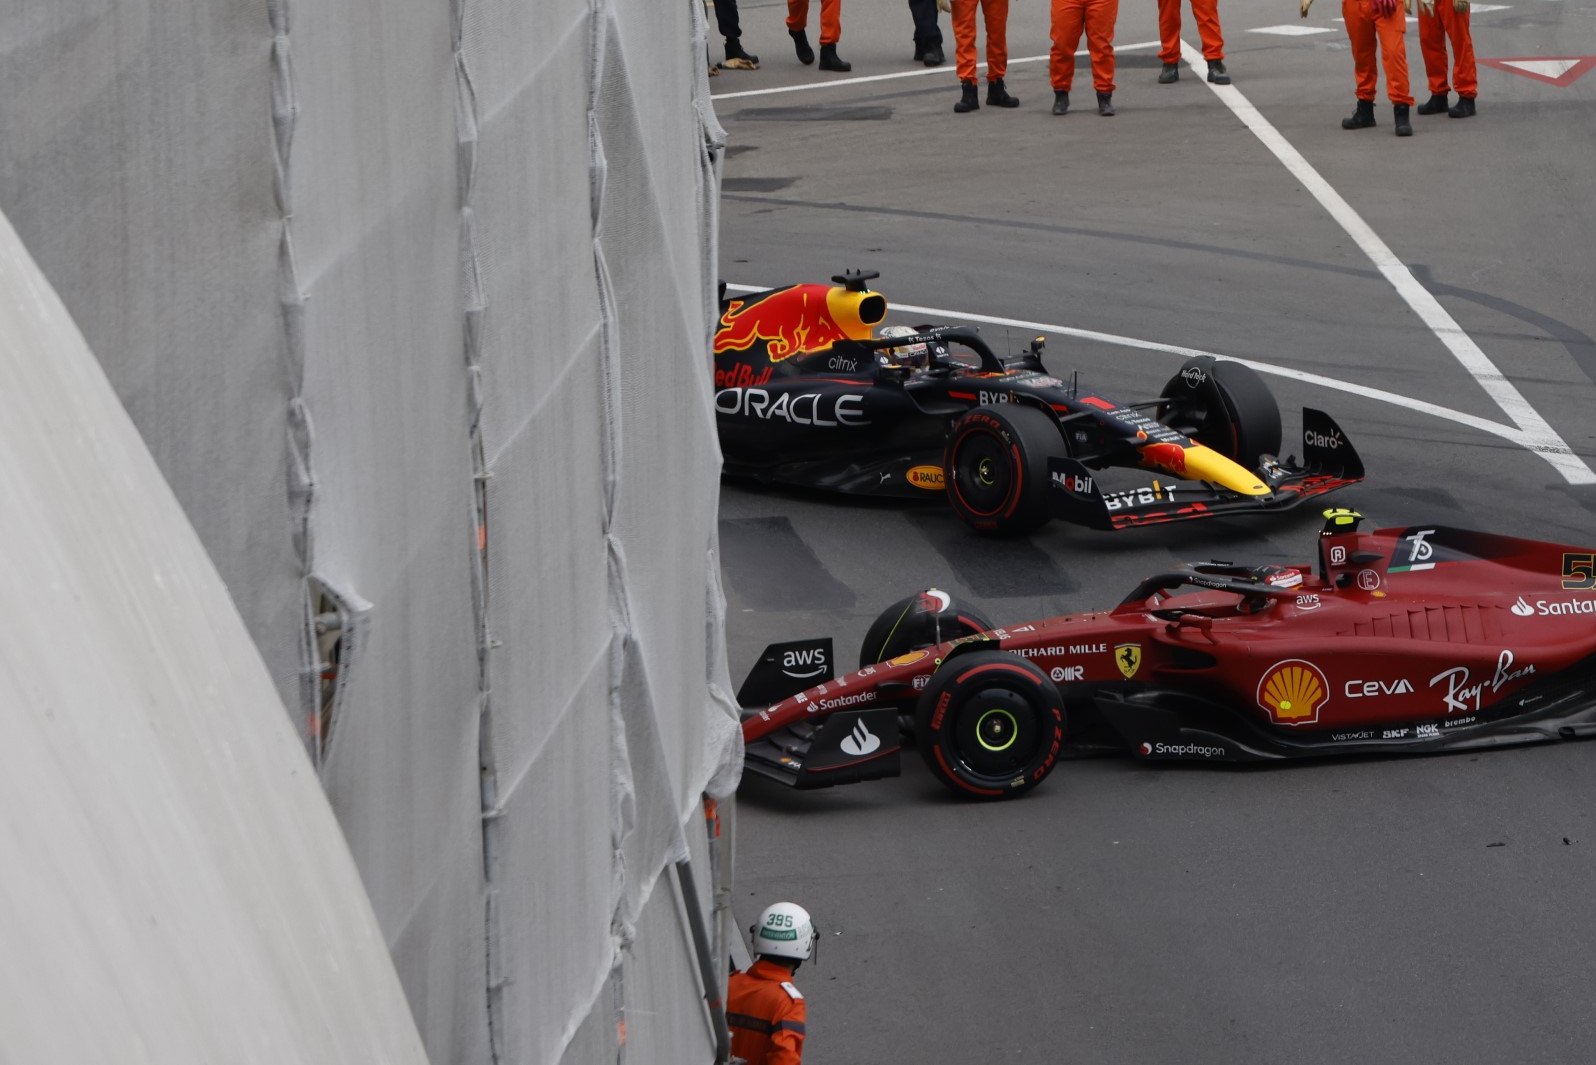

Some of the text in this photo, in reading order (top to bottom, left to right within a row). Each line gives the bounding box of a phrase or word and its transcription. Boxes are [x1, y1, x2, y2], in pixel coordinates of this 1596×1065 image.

[828, 354, 857, 373] citrix
[714, 387, 872, 427] ORACLE
[964, 413, 1002, 430] ZERO
[1304, 429, 1339, 450] Claro
[920, 472, 944, 484] RAUC
[1052, 470, 1093, 494] Mobil
[1102, 479, 1177, 511] BYBIT
[1296, 593, 1320, 605] aws
[1069, 643, 1108, 655] MILLE
[783, 648, 826, 667] aws
[819, 690, 878, 710] Santander
[1416, 723, 1440, 735] NGK
[1444, 716, 1476, 728] brembo
[1382, 728, 1410, 739] SKF
[1155, 742, 1226, 758] Snapdragon
[766, 913, 794, 928] 395
